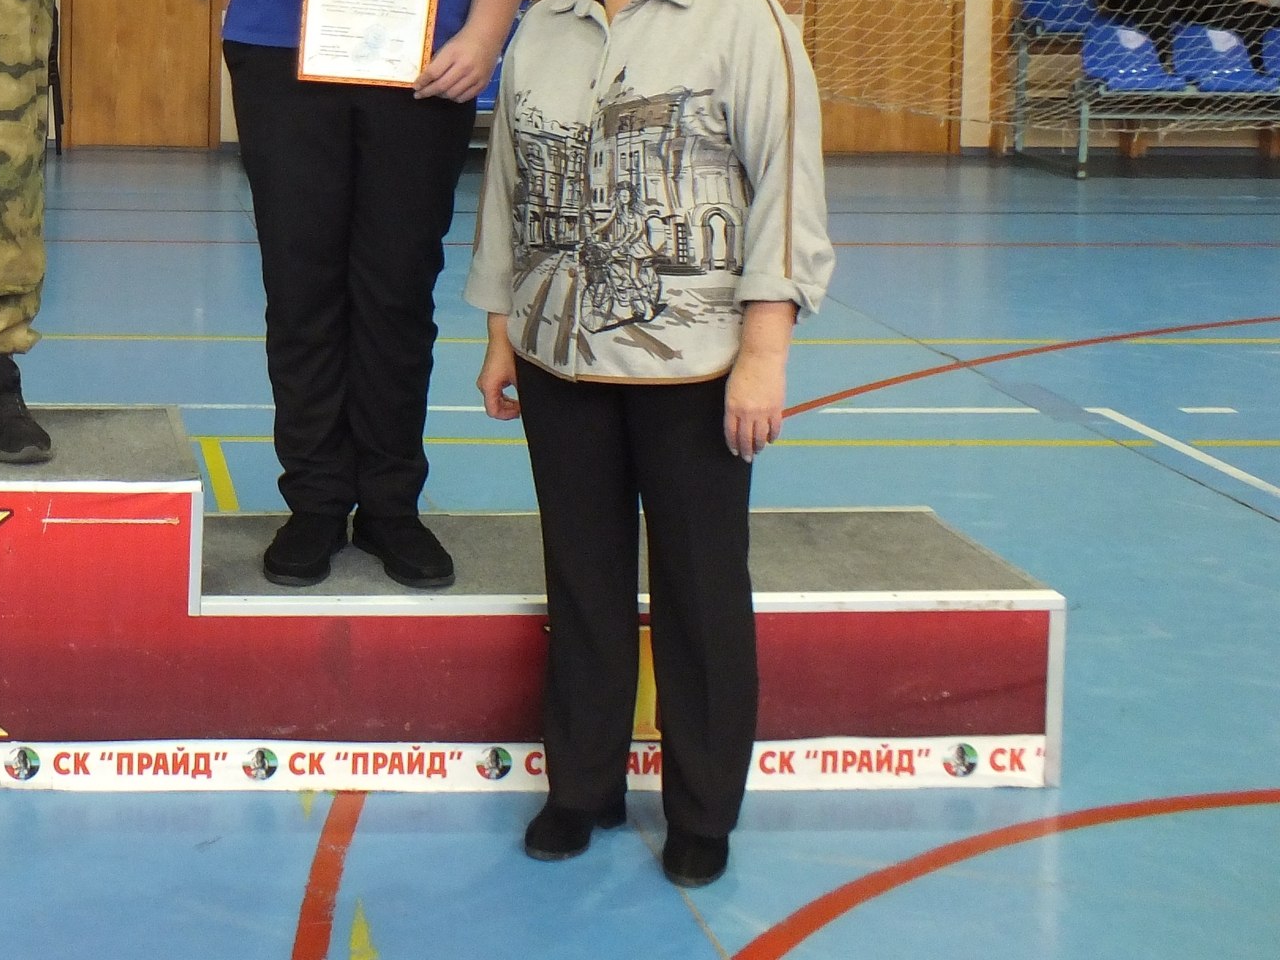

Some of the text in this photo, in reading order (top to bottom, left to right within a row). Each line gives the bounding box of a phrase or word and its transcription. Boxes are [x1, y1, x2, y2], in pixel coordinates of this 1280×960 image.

[53, 752, 90, 775] СК
[288, 752, 325, 775] СК
[524, 752, 547, 776] С
[759, 751, 796, 774] СК
[989, 748, 1026, 772] СК
